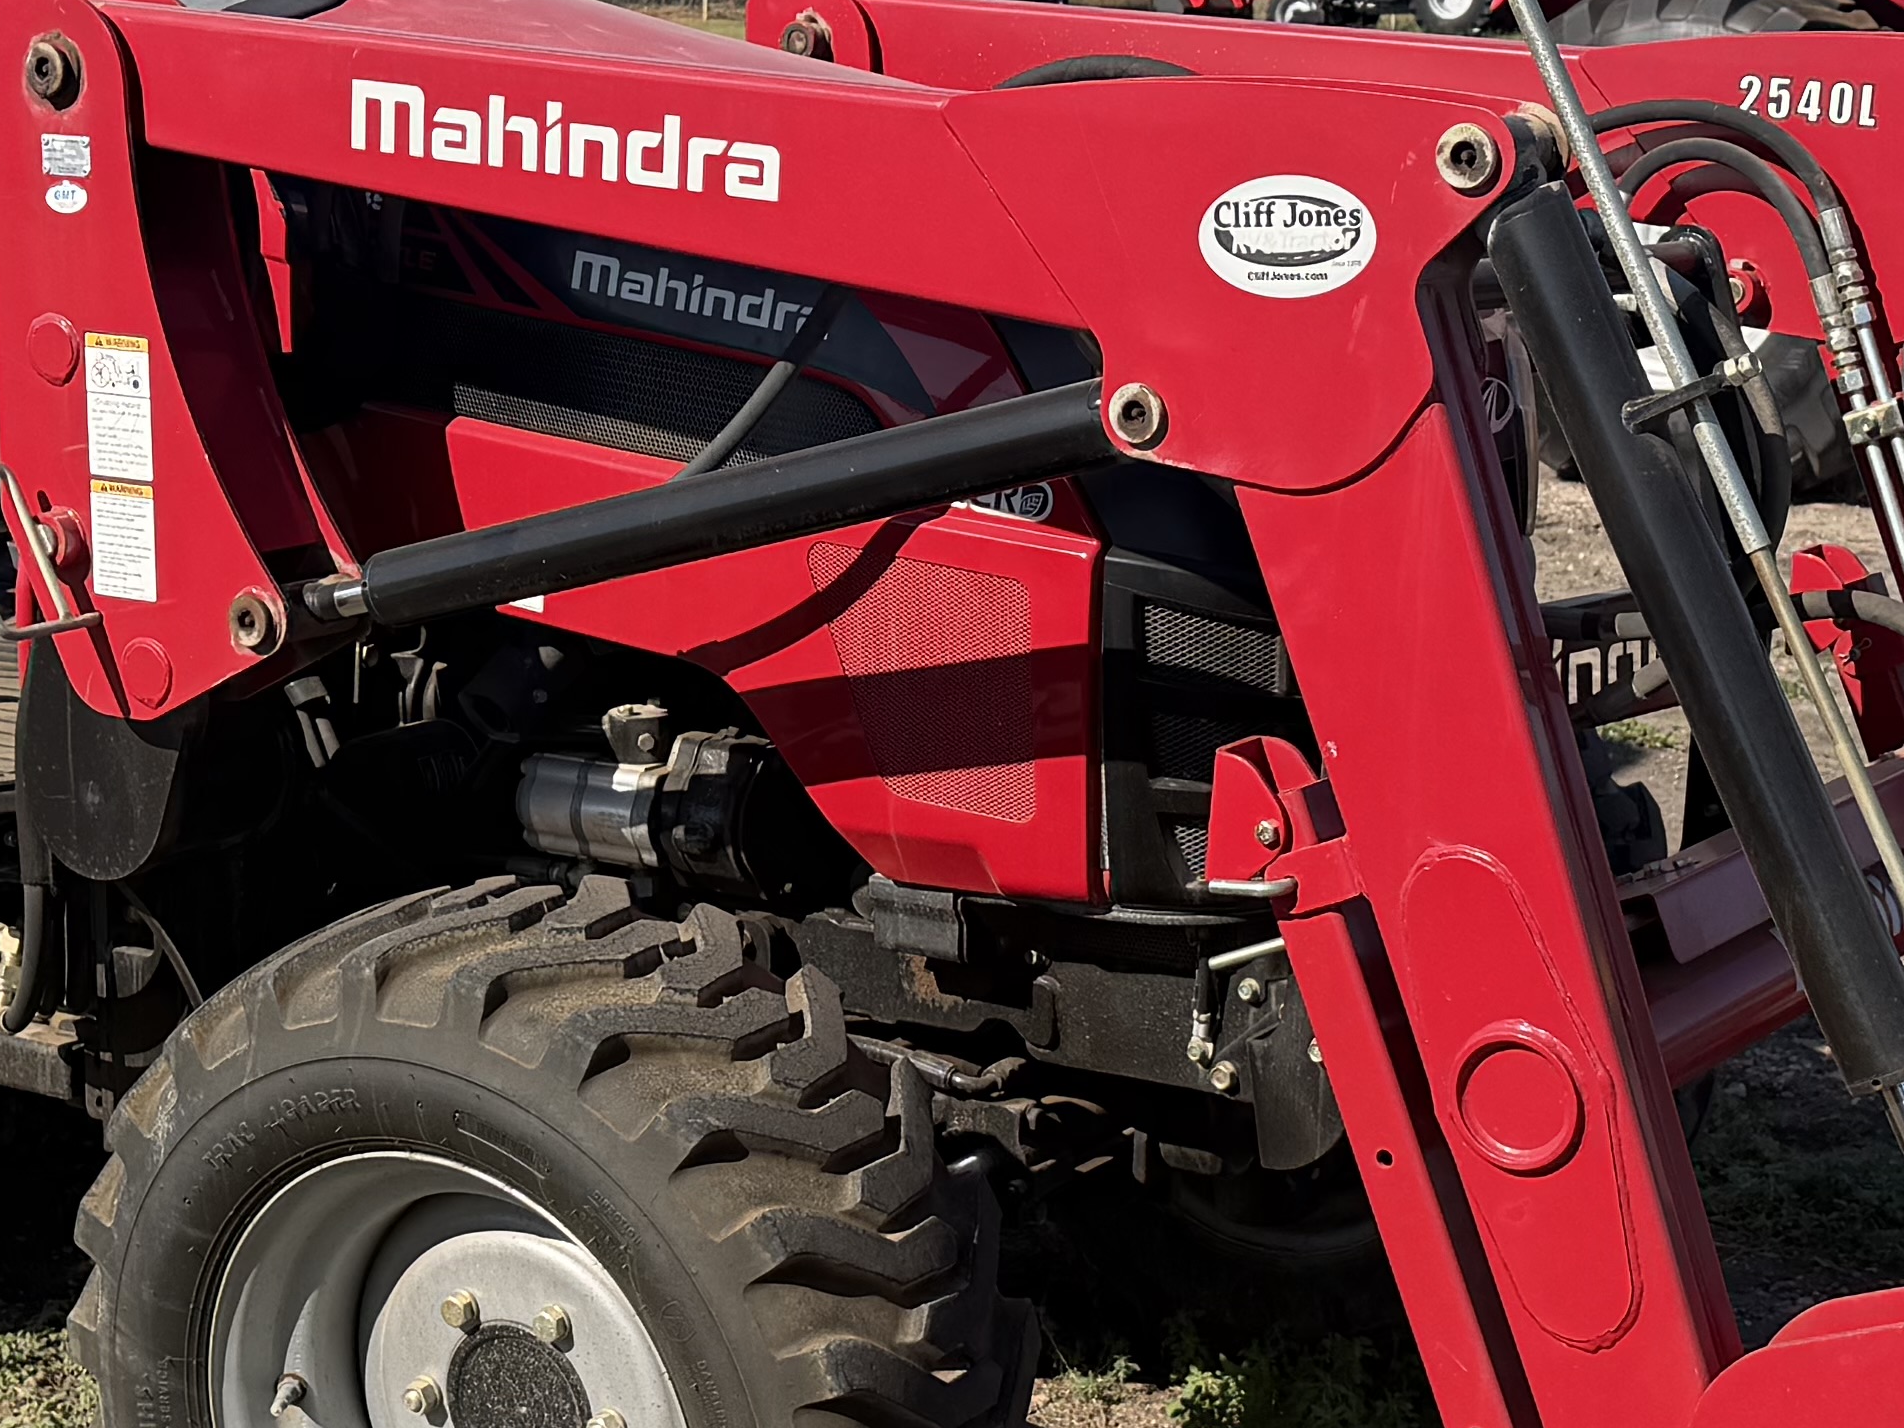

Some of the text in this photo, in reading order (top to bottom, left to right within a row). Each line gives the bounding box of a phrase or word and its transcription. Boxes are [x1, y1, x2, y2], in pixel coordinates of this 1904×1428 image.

[1738, 75, 1877, 128] 2540L
[350, 78, 781, 202] Mahindra
[1213, 201, 1362, 228] Cliff Jones
